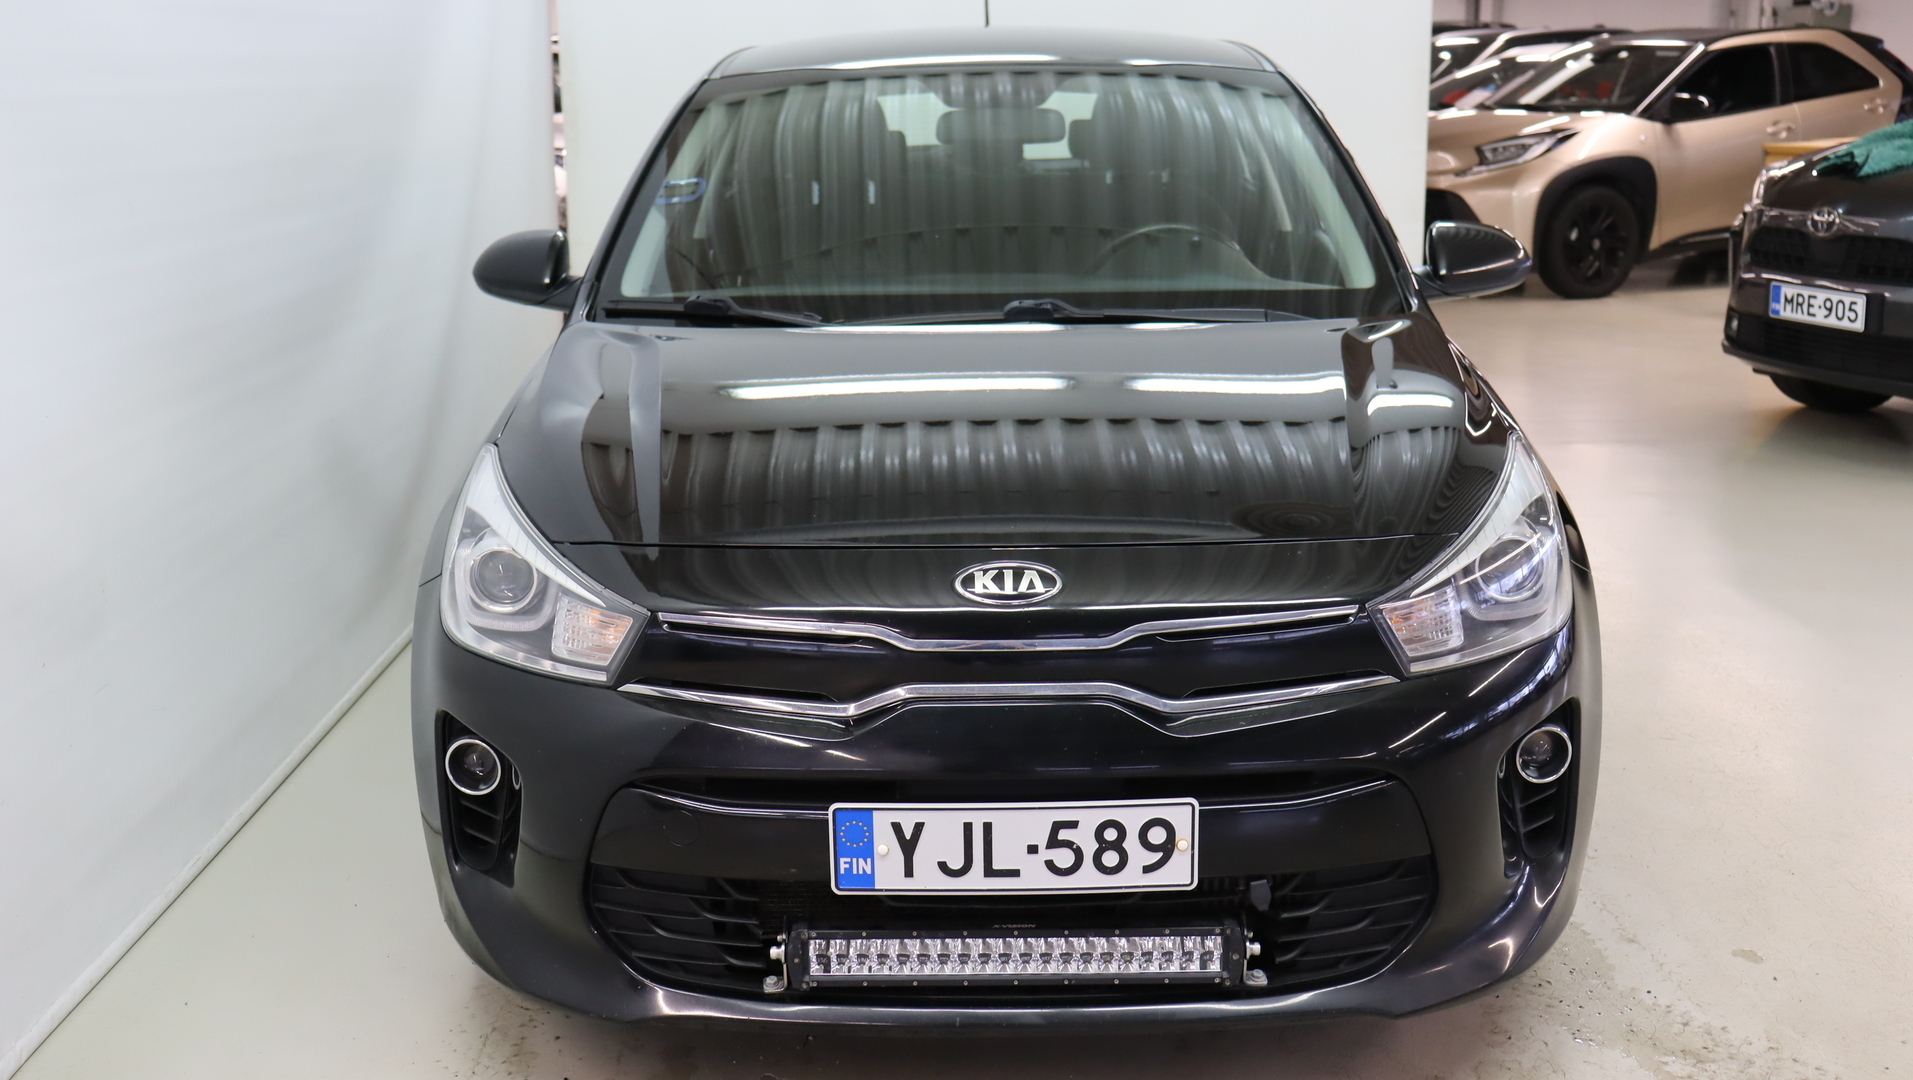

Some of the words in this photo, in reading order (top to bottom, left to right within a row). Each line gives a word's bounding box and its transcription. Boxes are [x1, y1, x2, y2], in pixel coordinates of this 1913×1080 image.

[1783, 291, 1859, 323] MRE-905
[971, 568, 1048, 595] KIA
[839, 857, 872, 875] FIN
[890, 816, 1177, 878] YJL-589
